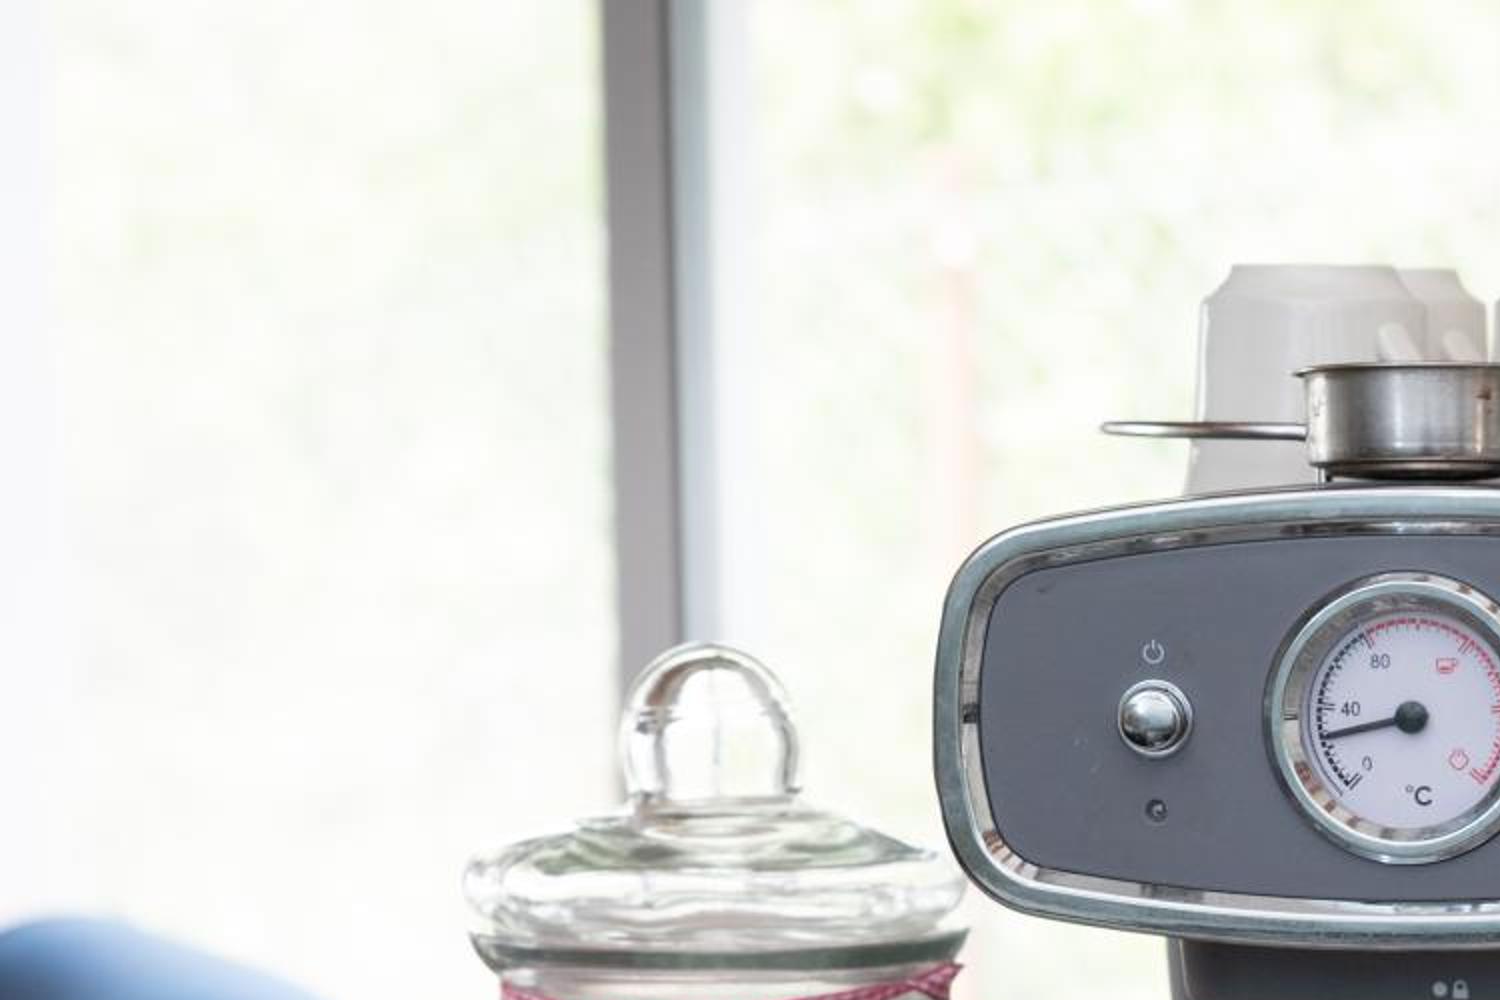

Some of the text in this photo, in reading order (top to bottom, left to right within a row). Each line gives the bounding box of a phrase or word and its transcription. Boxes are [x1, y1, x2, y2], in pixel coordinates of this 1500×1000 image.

[1370, 653, 1391, 669] 80
[1341, 701, 1361, 717] 40
[1361, 756, 1373, 771] 0
[1405, 785, 1433, 807] °C
